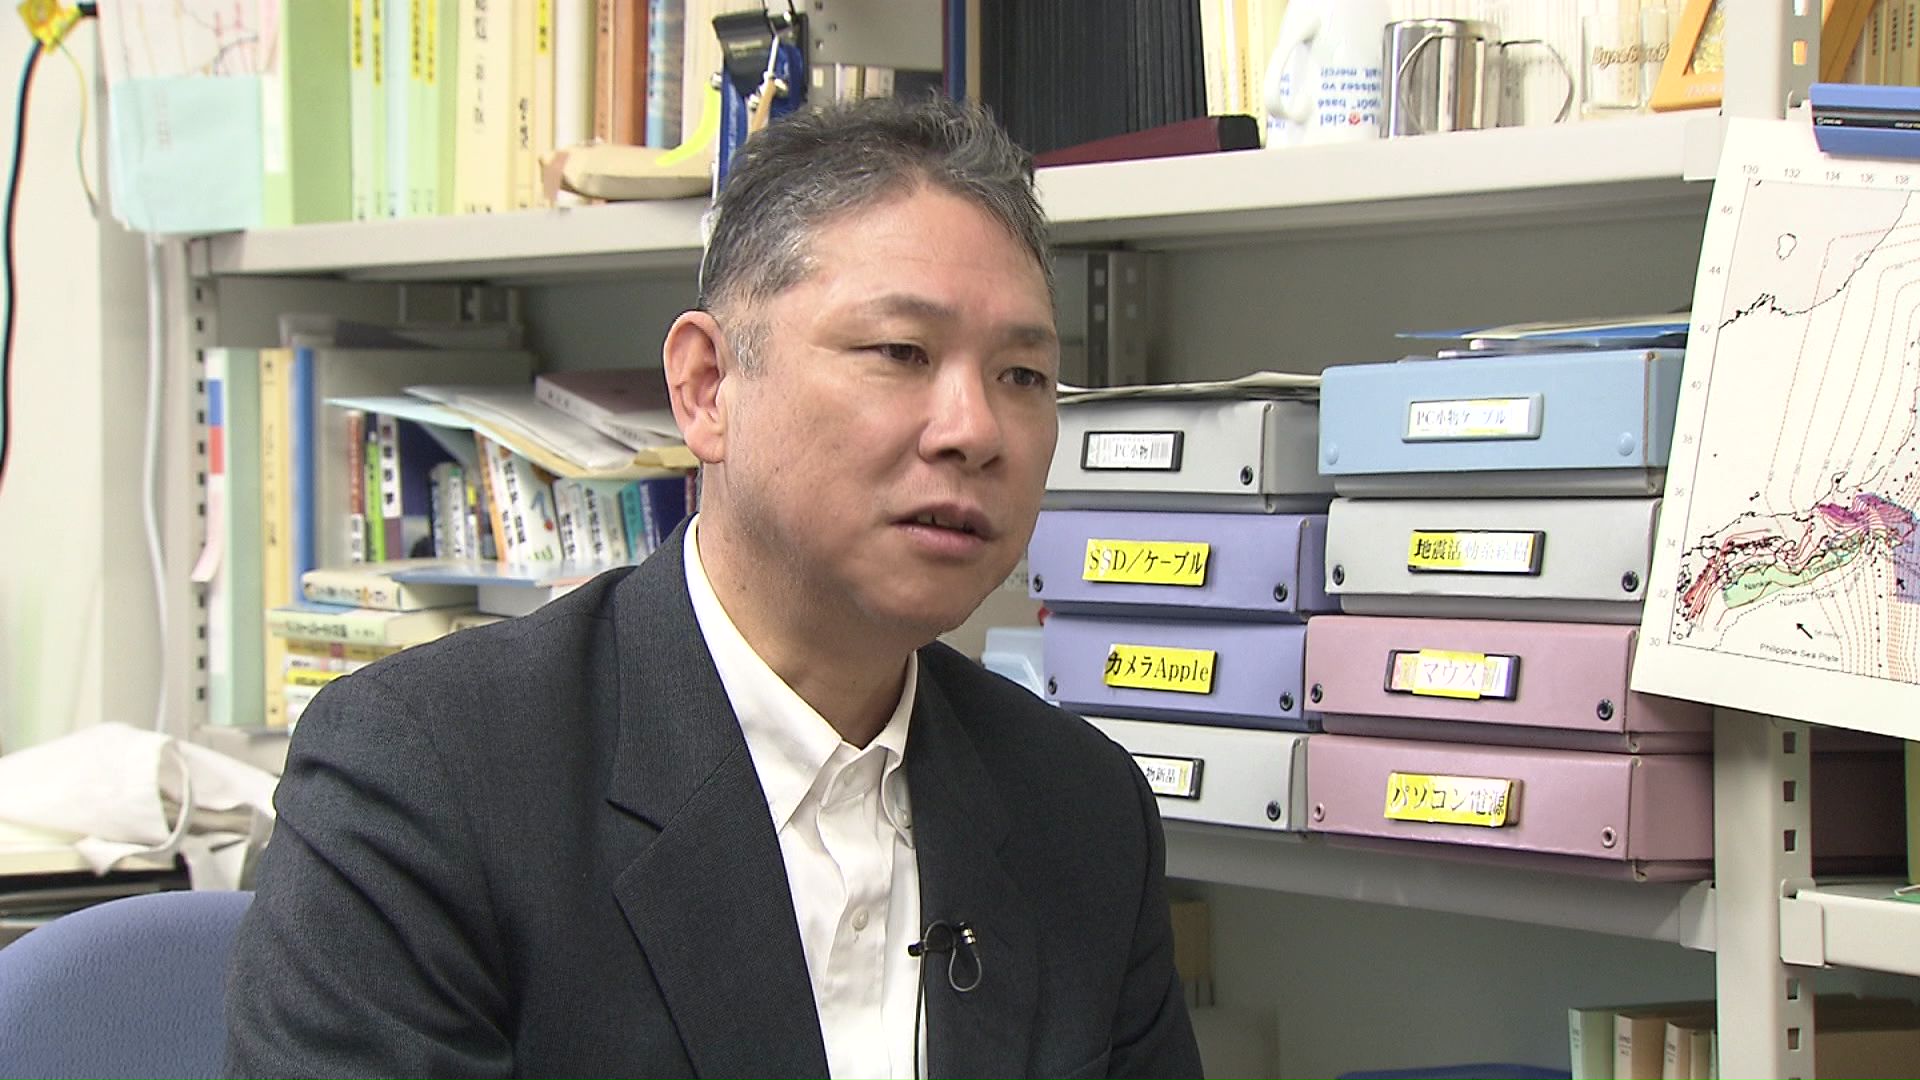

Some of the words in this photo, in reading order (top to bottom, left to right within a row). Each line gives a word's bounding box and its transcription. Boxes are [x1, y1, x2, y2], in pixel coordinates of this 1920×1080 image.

[1104, 651, 1209, 683] カメラApple
[1424, 658, 1478, 687] マウス
